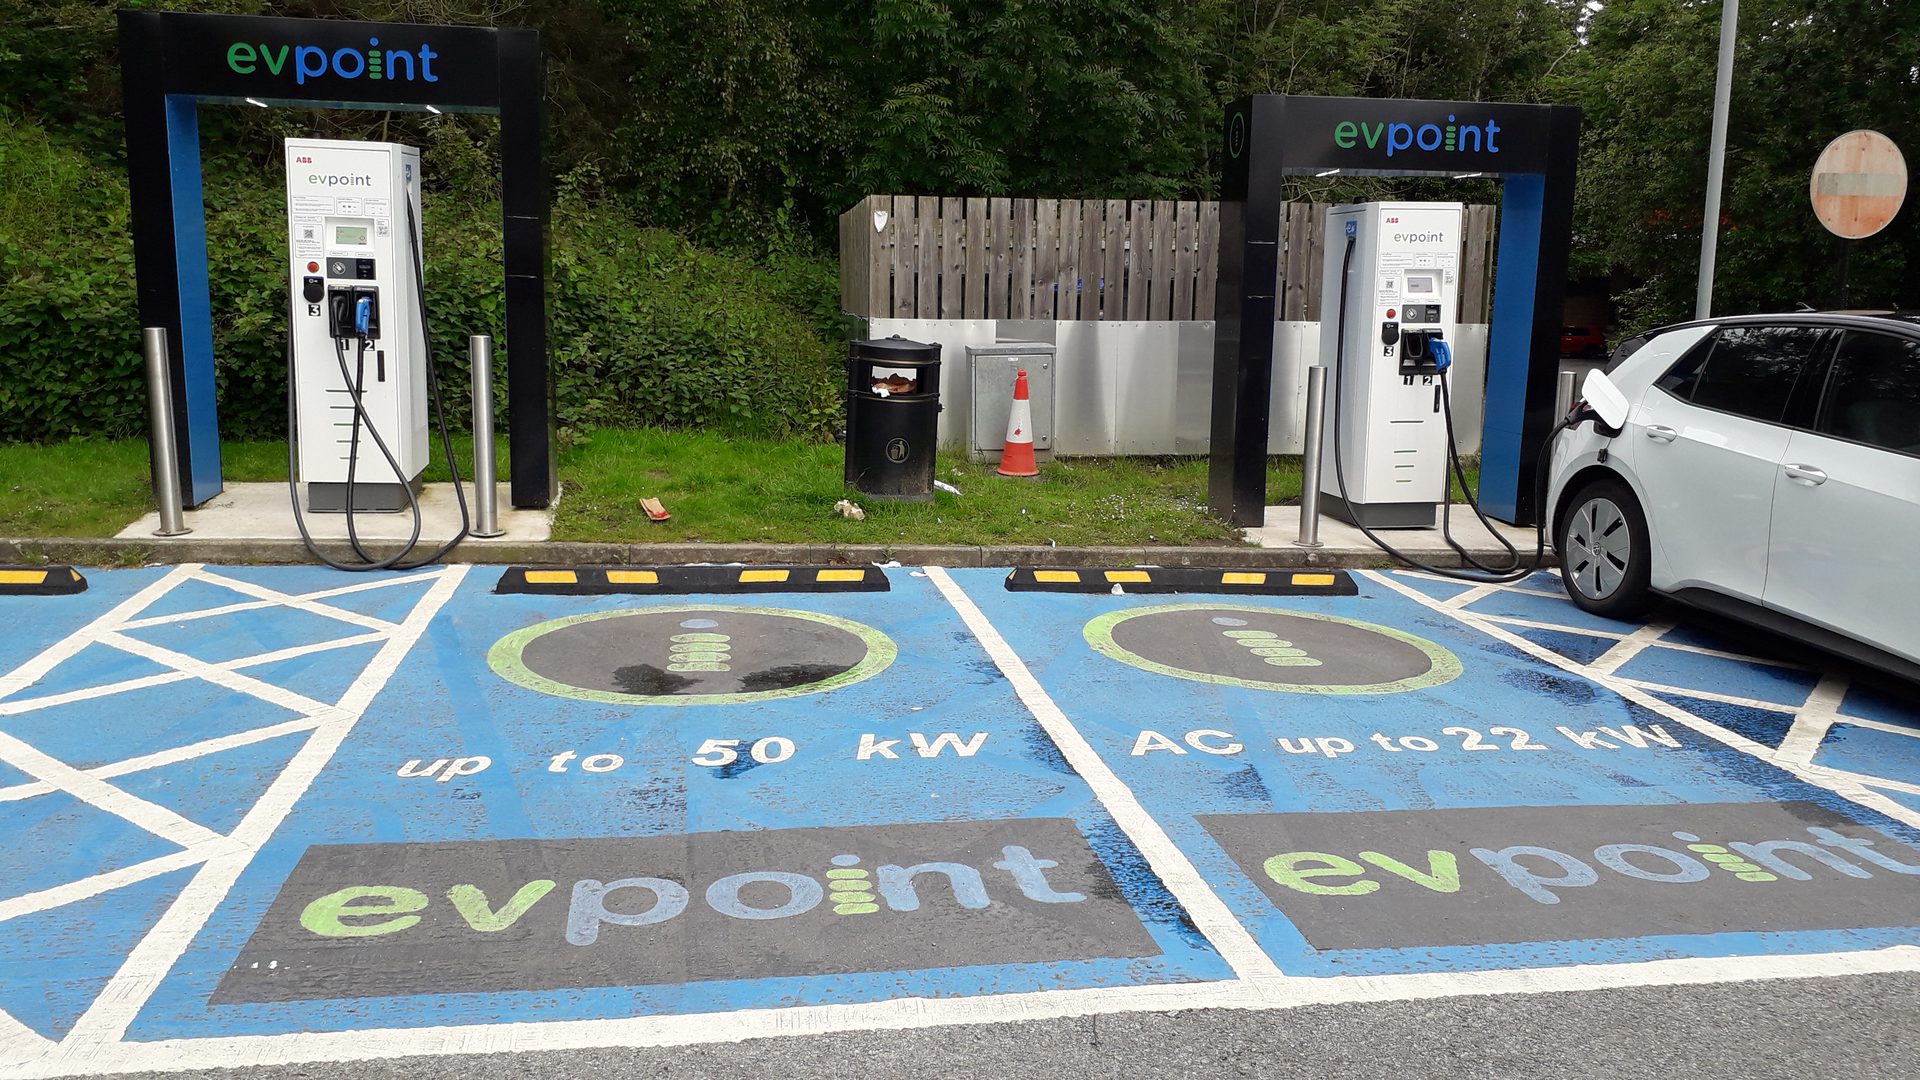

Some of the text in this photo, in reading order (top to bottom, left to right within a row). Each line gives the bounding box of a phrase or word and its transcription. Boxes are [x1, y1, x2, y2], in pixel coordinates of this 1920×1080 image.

[227, 37, 438, 85] evpoint
[1334, 114, 1500, 157] evpoint
[296, 156, 312, 164] ABB
[308, 172, 371, 187] evpoint
[1394, 231, 1444, 244] evpoint
[310, 305, 320, 316] 3
[364, 340, 374, 351] 2
[1385, 346, 1393, 357] 3
[1424, 376, 1431, 386] 2
[1130, 724, 1684, 758] AC up to 22 kW
[396, 732, 989, 782] up to 50 kW
[1263, 826, 1920, 905] evpoint
[300, 844, 1086, 947] evpoint
